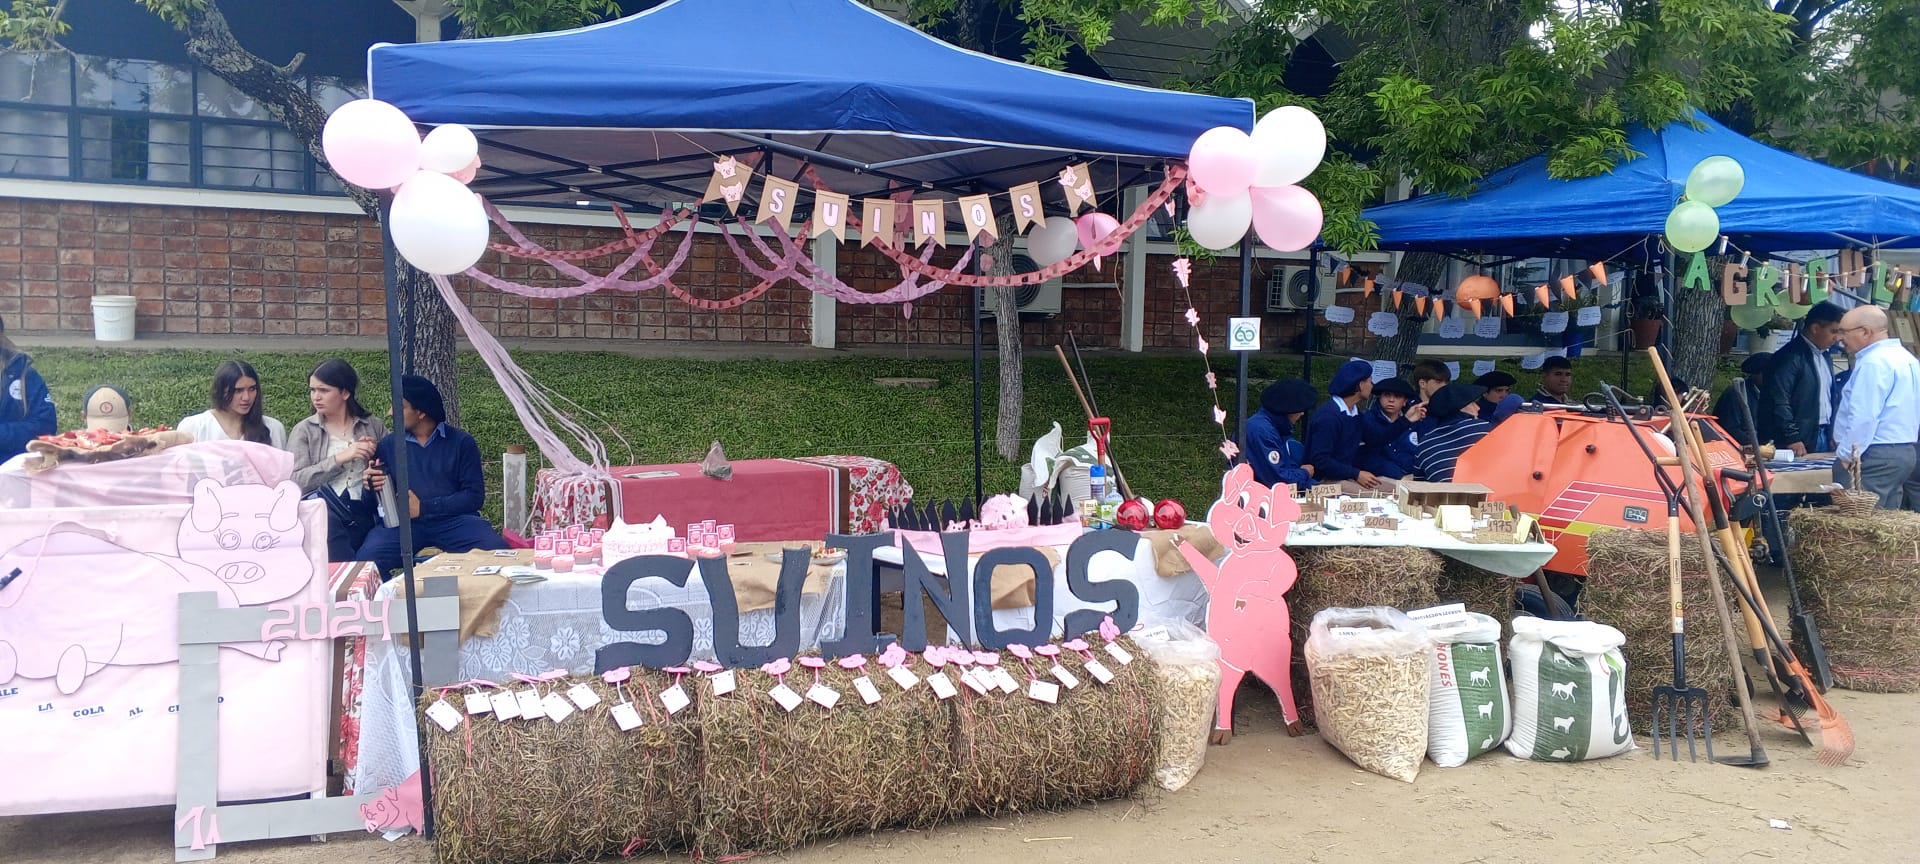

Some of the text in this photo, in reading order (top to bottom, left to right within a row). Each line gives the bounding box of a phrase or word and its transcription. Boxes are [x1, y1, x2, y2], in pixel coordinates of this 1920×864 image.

[769, 187, 1035, 235] SUINOS
[1299, 513, 1318, 522] 024
[1488, 520, 1513, 532] 1975
[595, 528, 1142, 675] SUINOS
[261, 600, 391, 641] 2024
[38, 703, 53, 712] LA
[73, 705, 105, 718] COLA
[128, 706, 144, 718] AL
